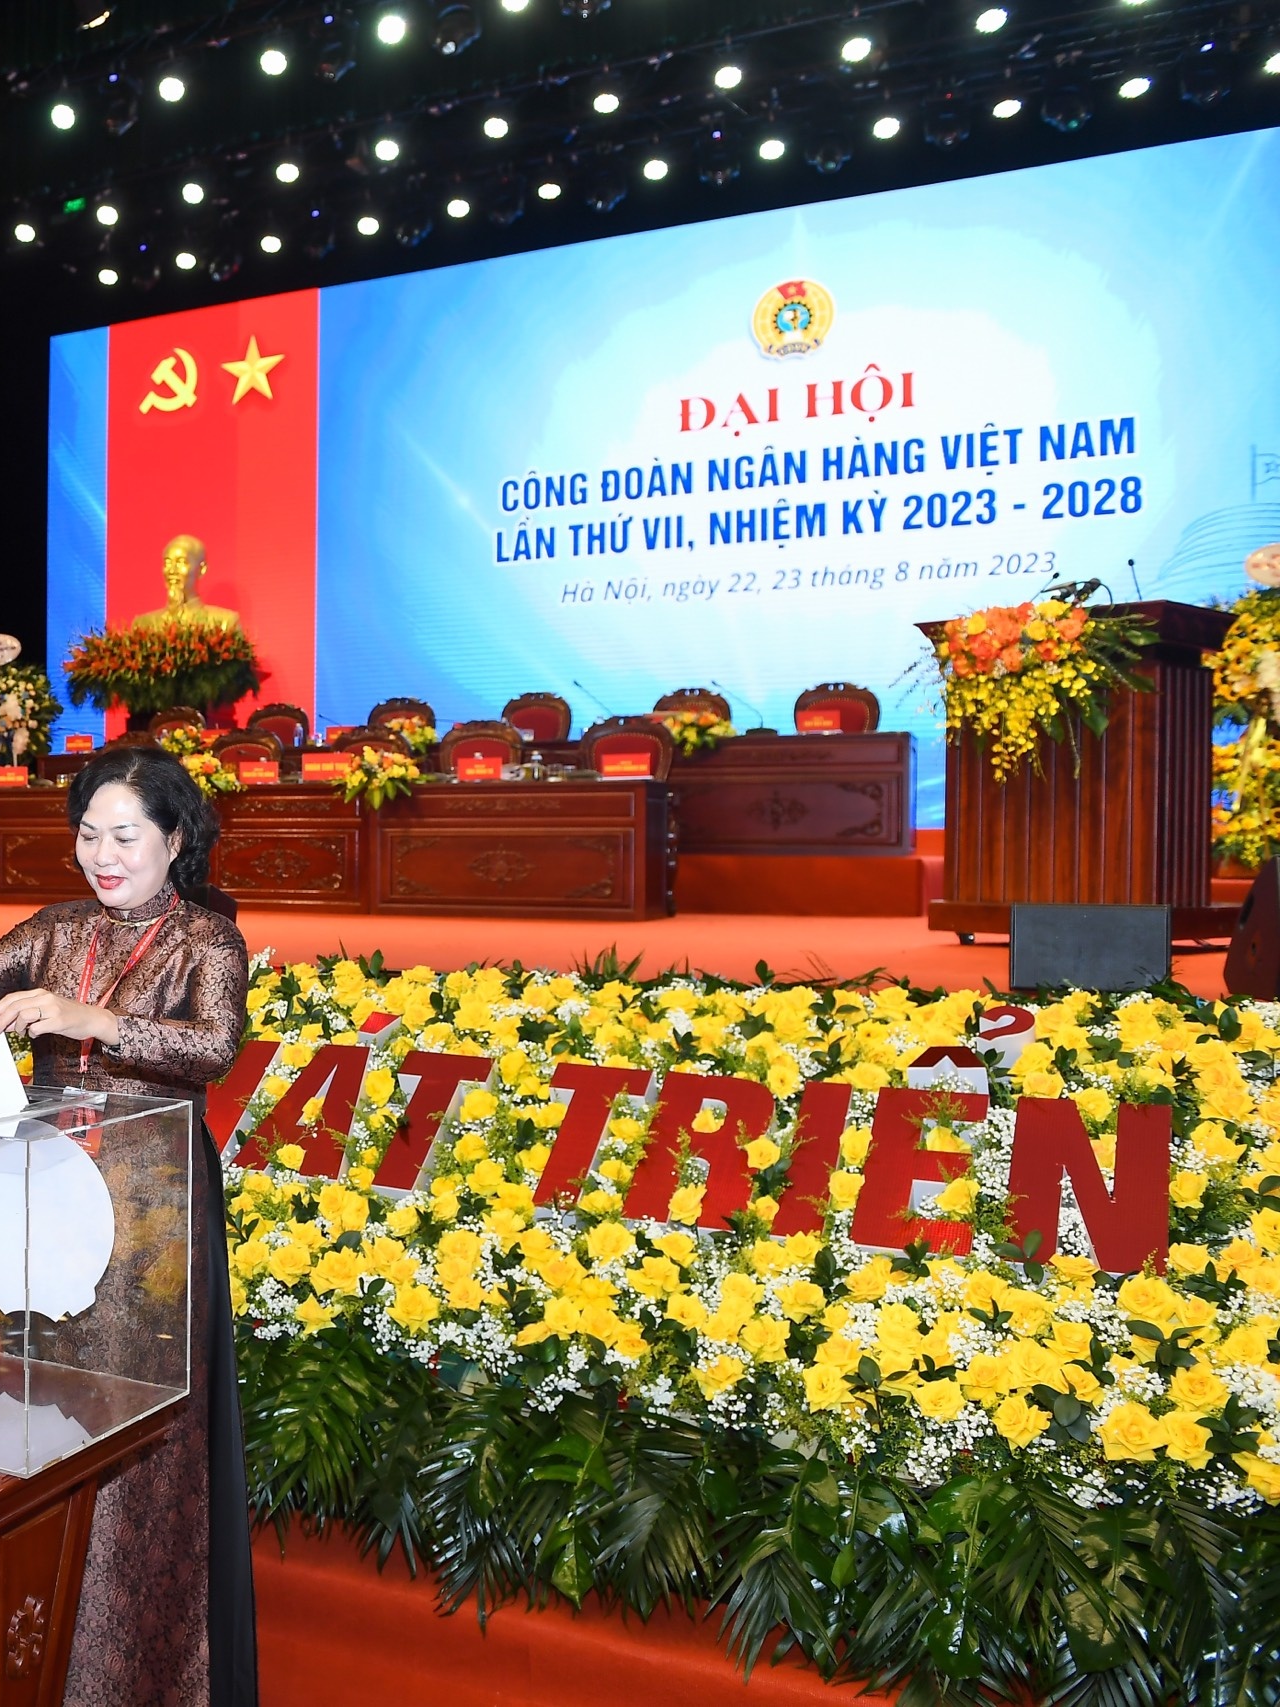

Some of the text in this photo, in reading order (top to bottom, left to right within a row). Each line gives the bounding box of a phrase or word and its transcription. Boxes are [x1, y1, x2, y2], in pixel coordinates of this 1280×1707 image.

[679, 361, 915, 437] ĐẠI HỘI
[501, 416, 1136, 512] CÔNG ĐOÀN NGÂN HÀNG VIỆT NAM
[496, 516, 556, 563] LẦN
[568, 511, 634, 557] THỨ
[643, 515, 695, 551] VII,
[709, 498, 826, 549] NHIỆM
[842, 489, 888, 535] KỲ
[902, 488, 997, 530] 2023
[1041, 475, 1142, 520] 2028
[561, 551, 1056, 605] Hà Nội, ngày 22, 23 tháng 8 năm 2023
[534, 1005, 1172, 1274] TRIỂN
